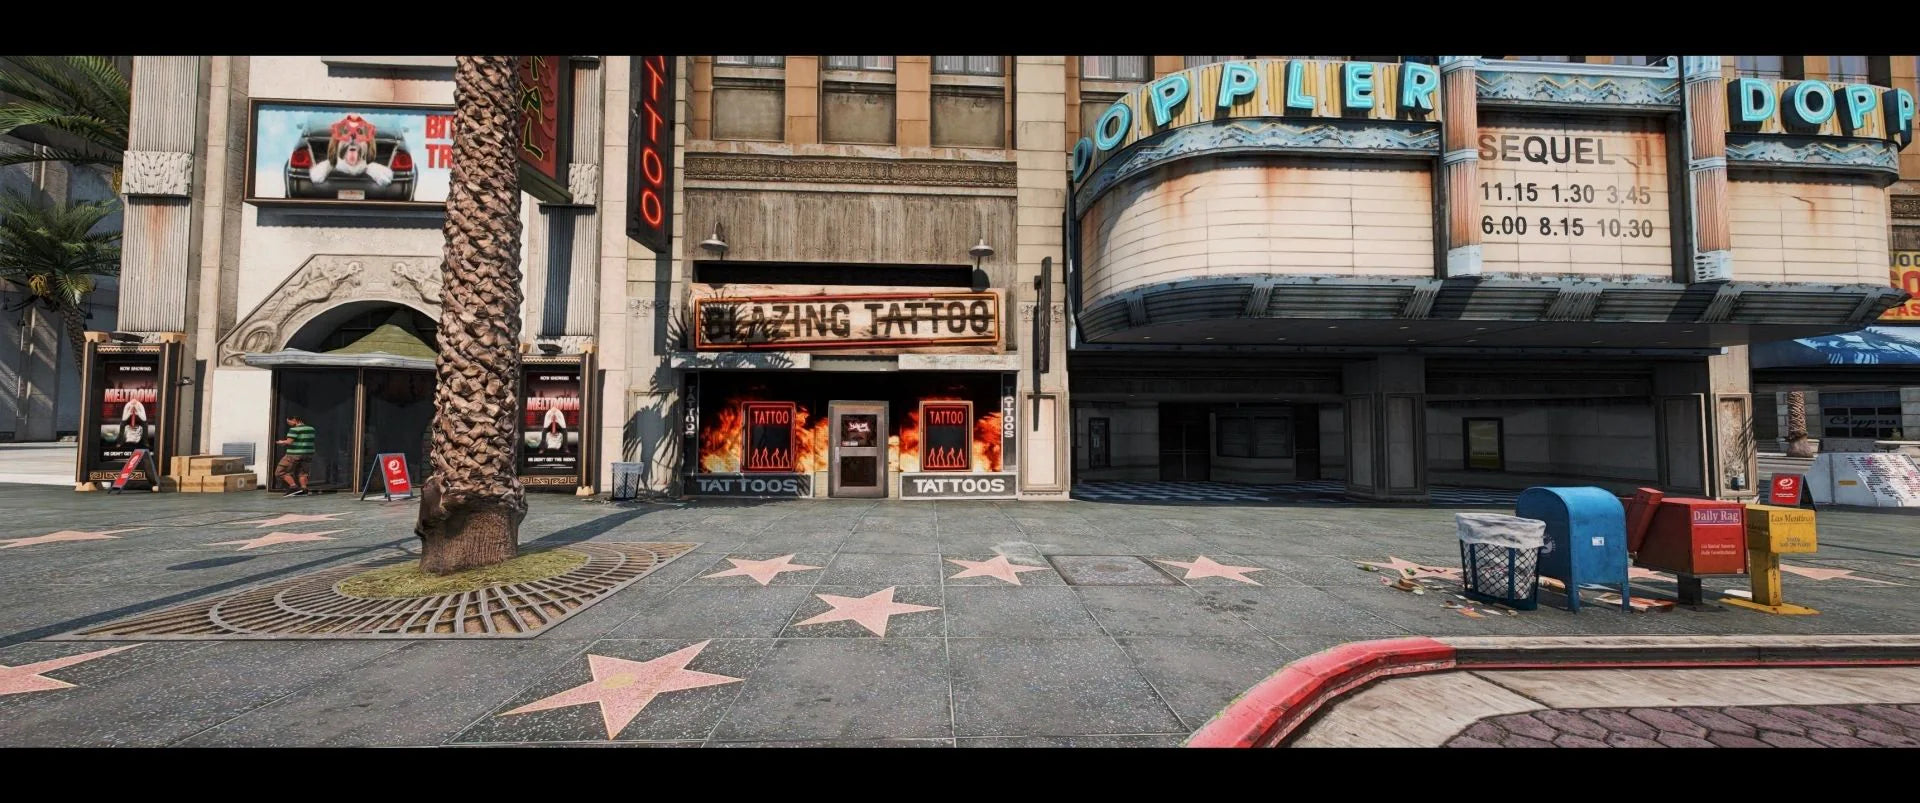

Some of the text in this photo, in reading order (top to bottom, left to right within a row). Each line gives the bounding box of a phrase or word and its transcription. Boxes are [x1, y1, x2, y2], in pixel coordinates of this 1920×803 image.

[1073, 60, 1437, 183] DOPPLER
[1477, 134, 1616, 164] SEQUEL
[1480, 181, 1651, 205] 11.15 1.30 3.45
[1481, 215, 1654, 238] 6.00 8.15 10.30
[704, 300, 990, 342] BLAZING TATTOO
[754, 411, 789, 425] TATTOO
[930, 411, 964, 425] TATTOO
[697, 479, 799, 492] TATTOOS
[913, 479, 1005, 493] TATTOOS
[1693, 510, 1739, 523] Daily Rag
